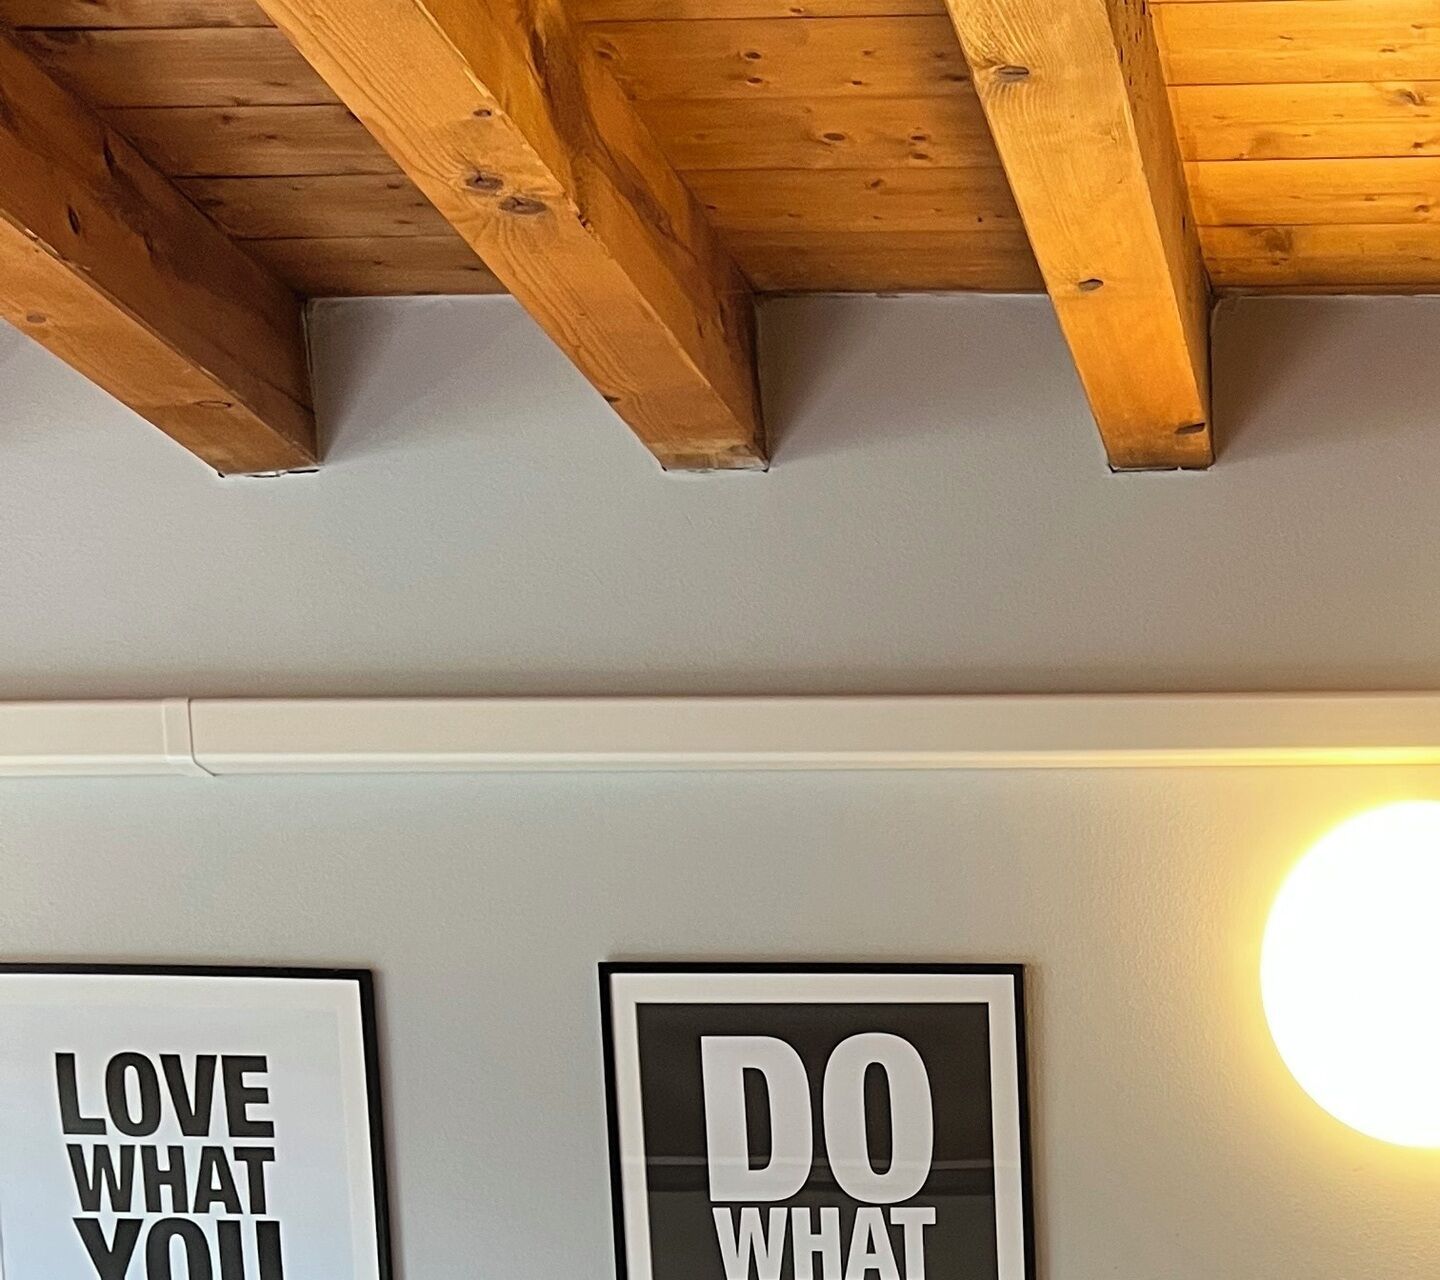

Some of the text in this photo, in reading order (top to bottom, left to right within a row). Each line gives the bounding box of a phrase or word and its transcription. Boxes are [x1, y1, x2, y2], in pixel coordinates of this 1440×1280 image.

[54, 1052, 275, 1138] LOVE
[700, 1032, 935, 1204] DO
[66, 1144, 276, 1216] WHAT
